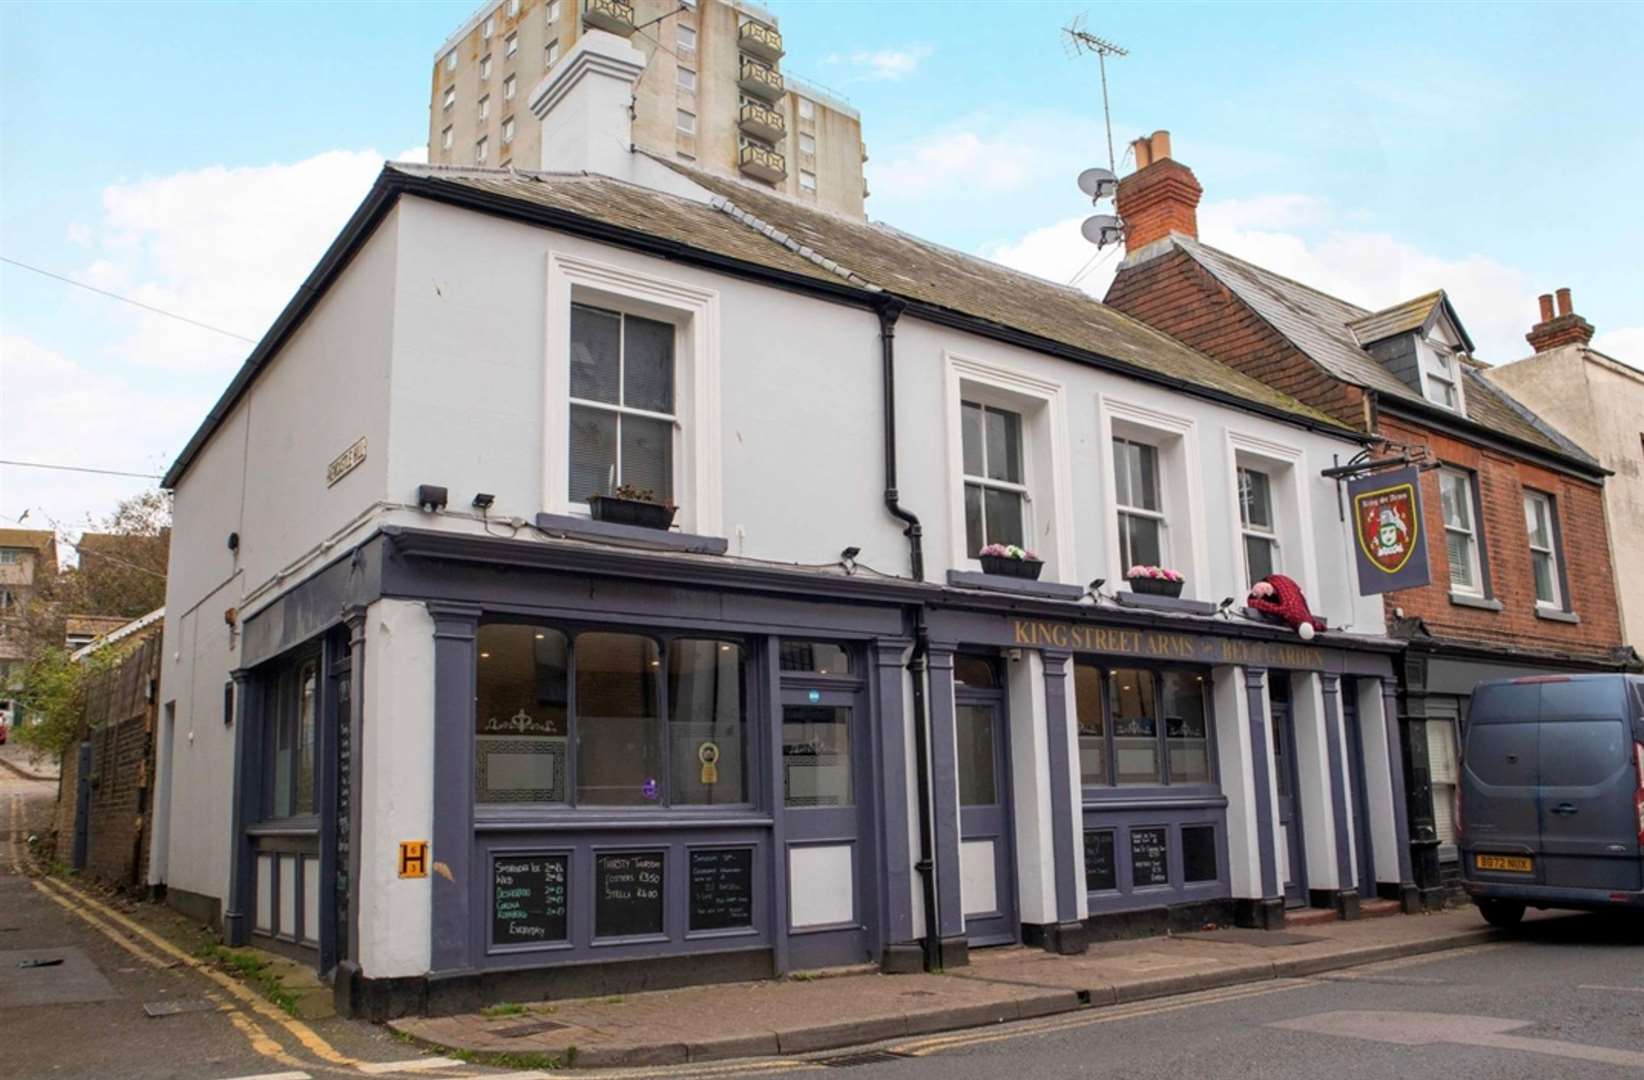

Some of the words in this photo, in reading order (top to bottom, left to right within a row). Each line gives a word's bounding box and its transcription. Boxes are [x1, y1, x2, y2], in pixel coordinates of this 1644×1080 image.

[1015, 621, 1067, 647] KING
[1071, 626, 1142, 653] STREET
[1147, 634, 1193, 658] ARMS
[403, 844, 425, 873] H
